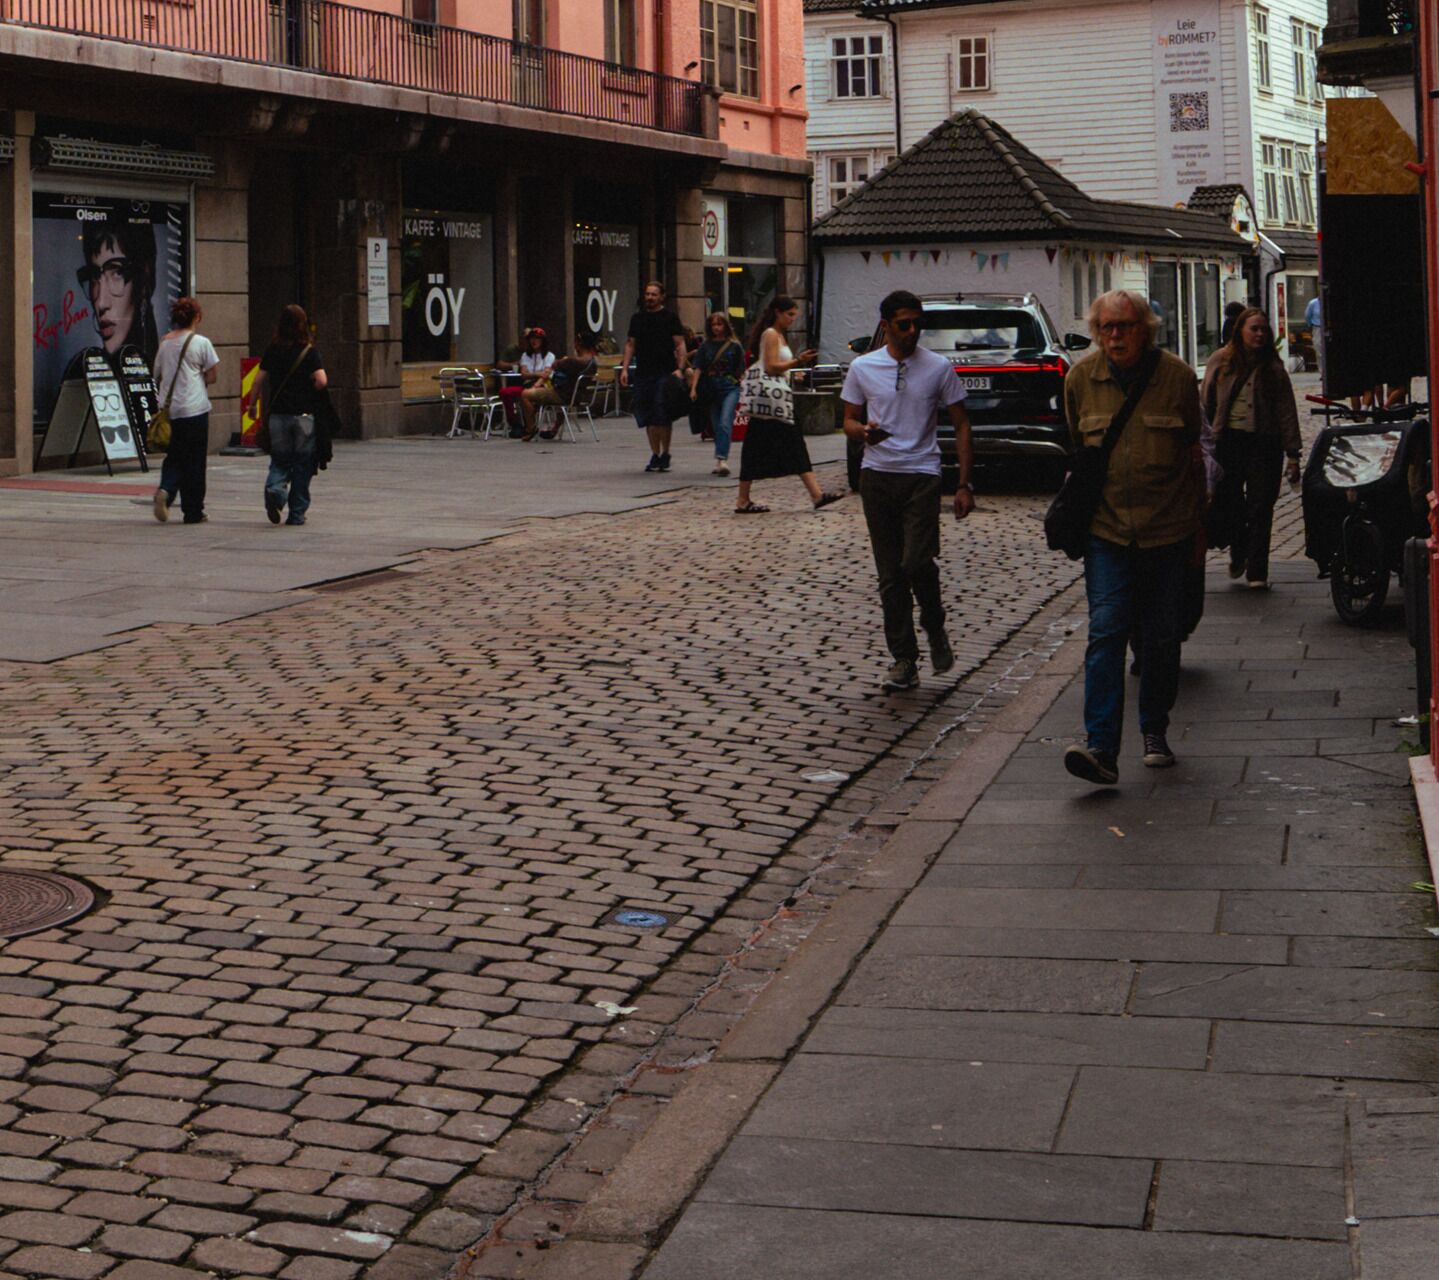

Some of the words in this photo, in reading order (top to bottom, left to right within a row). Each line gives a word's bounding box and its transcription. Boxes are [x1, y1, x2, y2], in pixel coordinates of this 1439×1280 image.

[1177, 18, 1196, 30] Leie
[1158, 31, 1216, 48] byROMMET?
[76, 208, 107, 221] Olsen
[405, 219, 435, 236] KAFFE
[442, 222, 482, 239] VINTAGE
[706, 221, 716, 239] 22
[599, 231, 630, 248] VINTAGE
[374, 242, 381, 258] P
[425, 273, 466, 336] ÖY
[586, 277, 618, 333] ÖY
